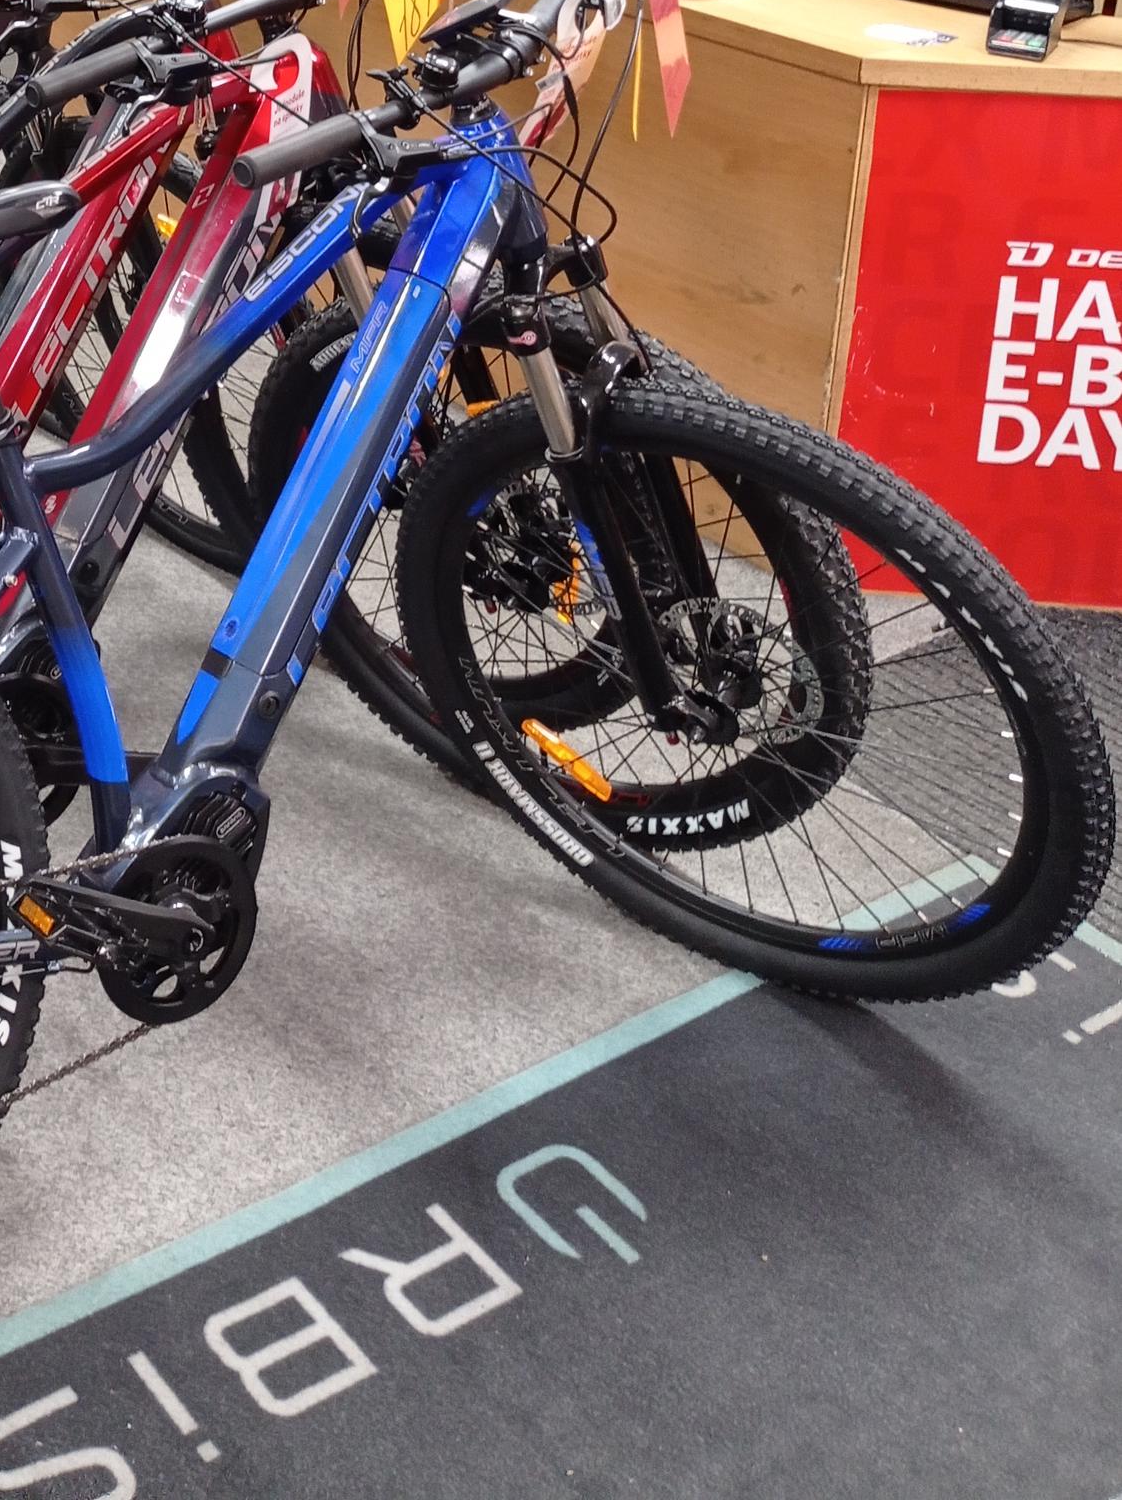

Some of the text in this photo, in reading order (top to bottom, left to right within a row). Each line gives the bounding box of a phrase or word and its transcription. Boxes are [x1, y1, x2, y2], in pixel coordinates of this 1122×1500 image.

[34, 190, 62, 210] CTR
[244, 181, 372, 302] ESCON
[993, 275, 1122, 345] HA
[309, 331, 359, 372] ARDEN
[984, 339, 1122, 408] E-B
[484, 757, 595, 868] CROSSMARK
[626, 798, 751, 836] MAXXIS
